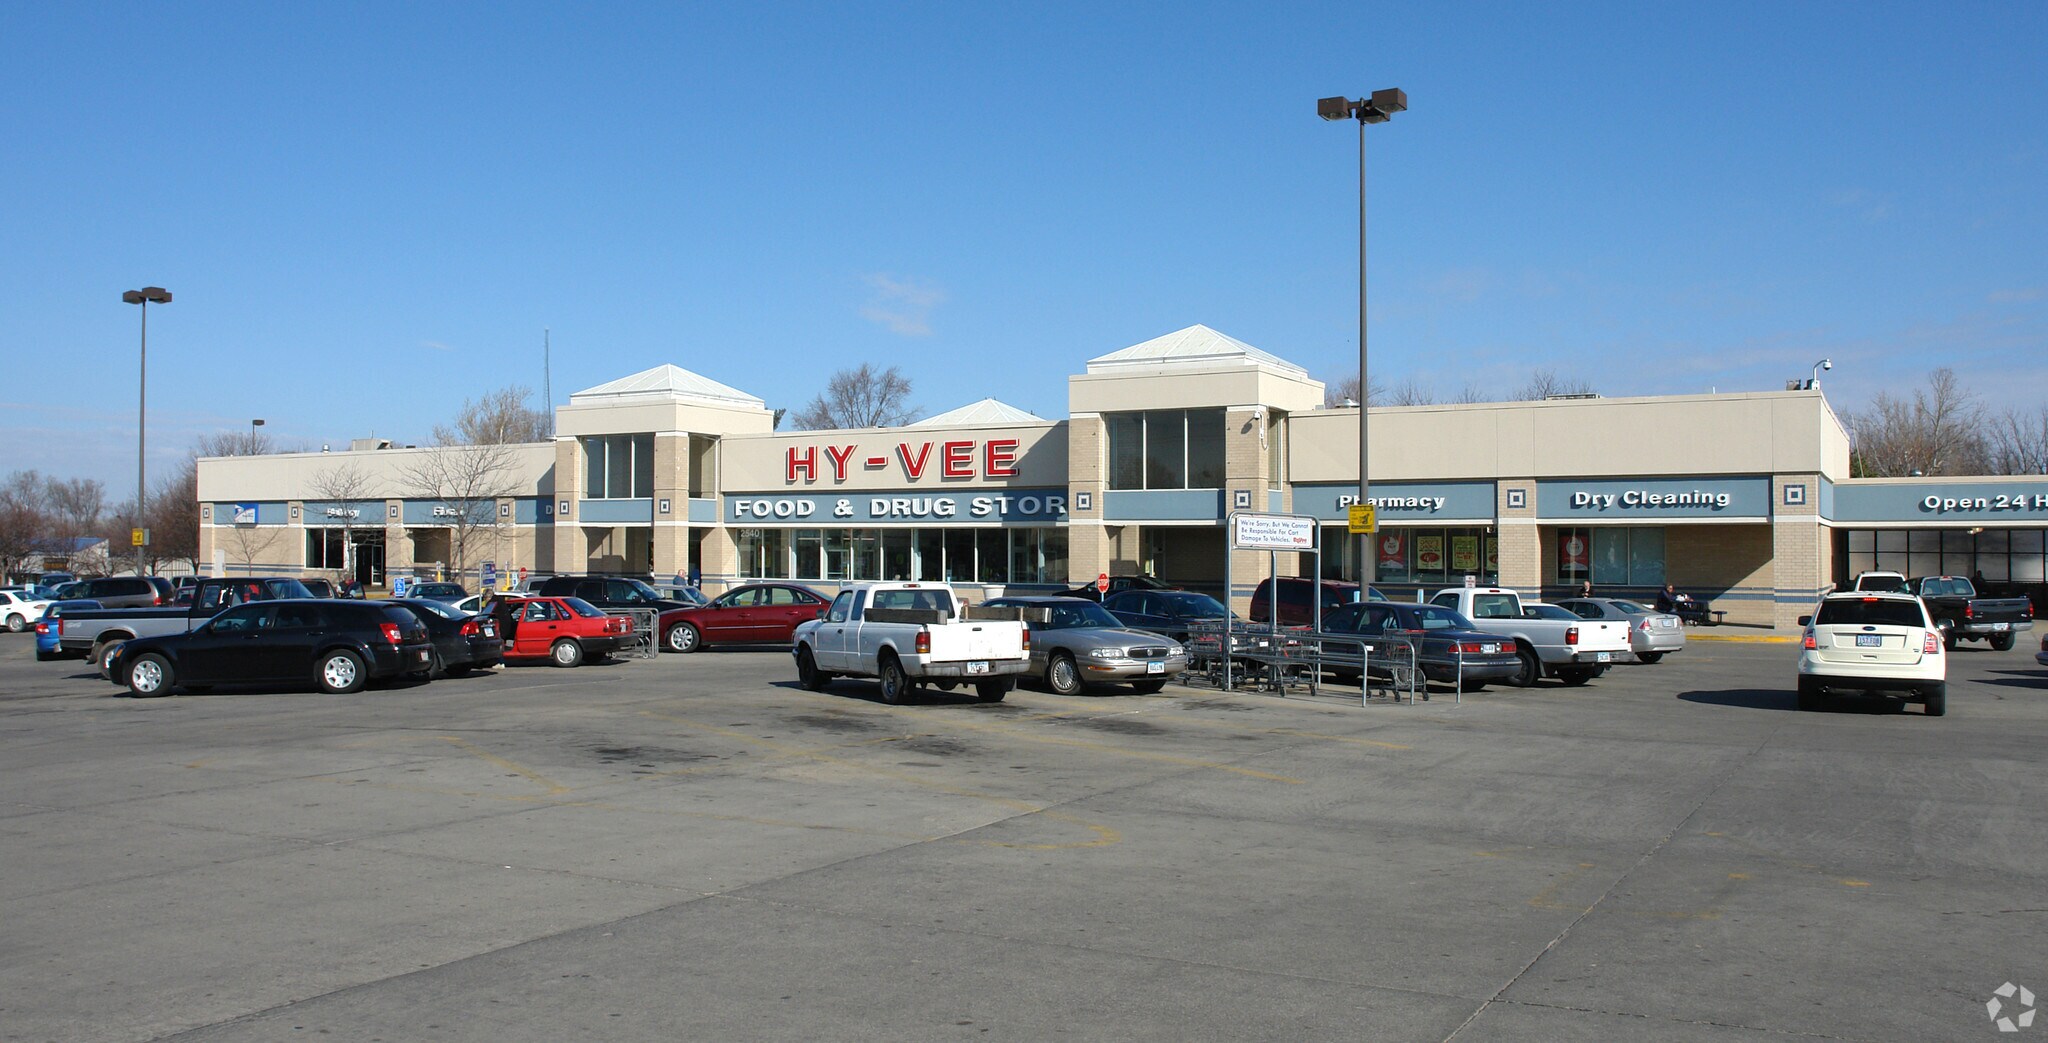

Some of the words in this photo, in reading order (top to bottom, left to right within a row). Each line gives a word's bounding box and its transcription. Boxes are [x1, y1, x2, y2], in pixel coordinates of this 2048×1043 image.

[787, 439, 1019, 481] HY-VEE
[1575, 491, 1615, 507] Dry
[1623, 490, 1730, 507] Cleaning
[1924, 495, 1987, 511] Open
[1995, 494, 2026, 508] 24
[735, 499, 816, 517] FOOD
[834, 498, 854, 516] &
[870, 497, 956, 516] DRUG
[1249, 527, 1277, 536] Responsible
[1291, 522, 1309, 530] Cannot
[740, 529, 760, 538] 2540
[1241, 534, 1261, 543] Damage
